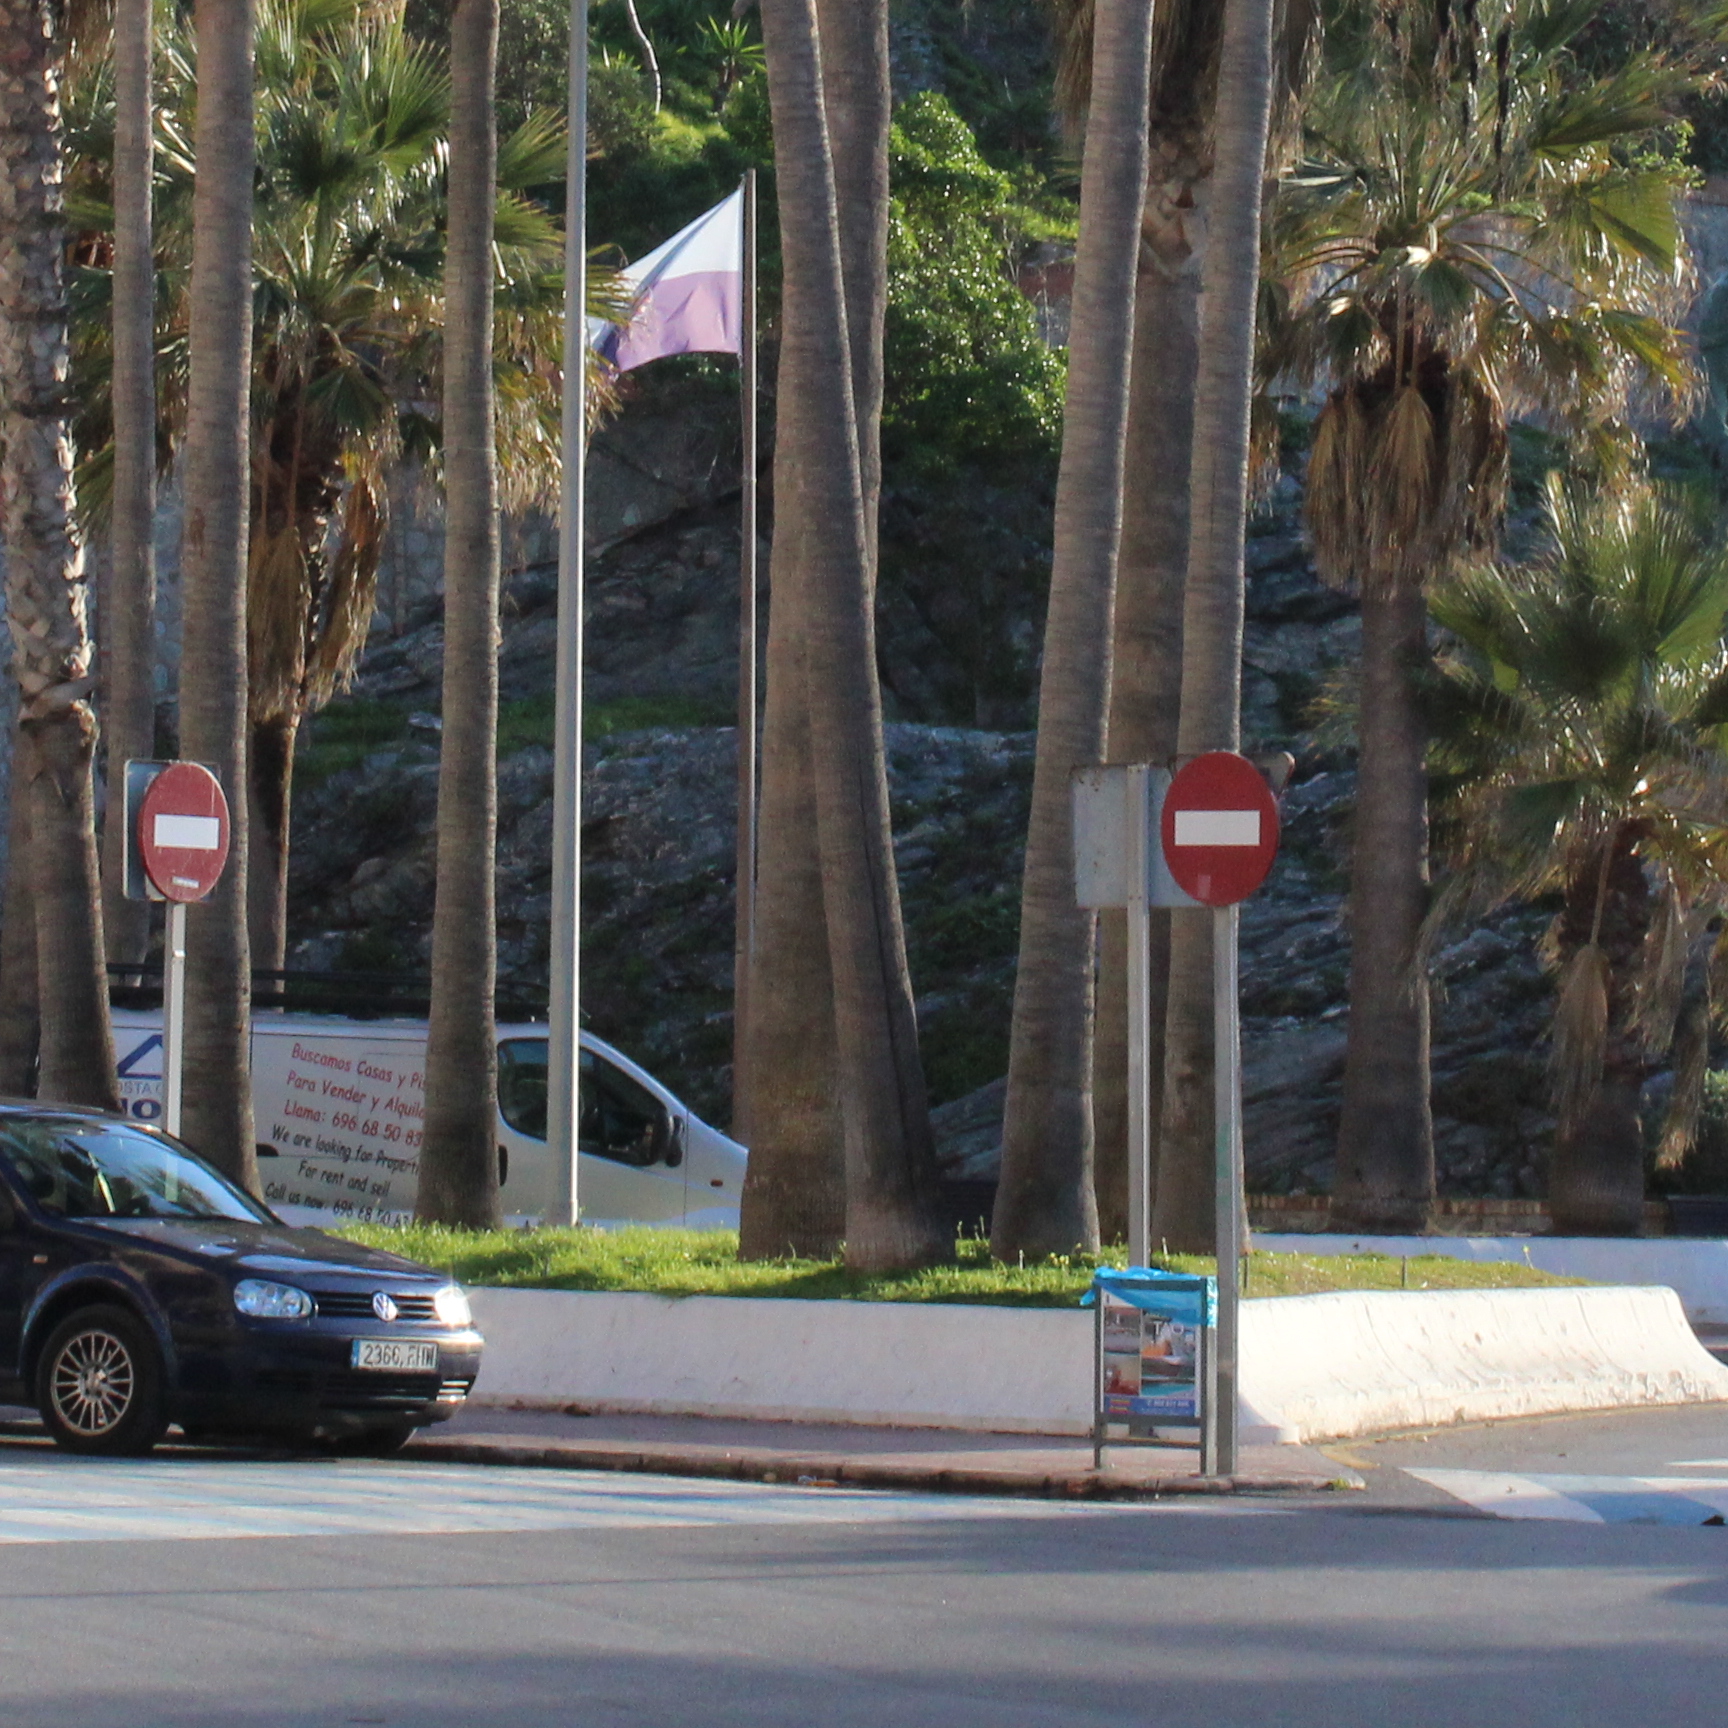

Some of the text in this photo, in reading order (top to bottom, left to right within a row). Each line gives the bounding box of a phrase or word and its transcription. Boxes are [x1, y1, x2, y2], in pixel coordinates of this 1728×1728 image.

[291, 1042, 425, 1090] Buscamos Casas y Pi
[287, 1069, 317, 1092] Para
[322, 1080, 367, 1104] Vender
[371, 1095, 381, 1112] y
[272, 1123, 290, 1143] We
[293, 1133, 312, 1148] are
[315, 1133, 352, 1163] looking
[354, 1144, 373, 1162] for
[284, 1099, 424, 1148] Llama: 696 68 50 83
[265, 1181, 287, 1200] Call
[288, 1191, 301, 1205] us
[298, 1158, 392, 1198] For rent and sell
